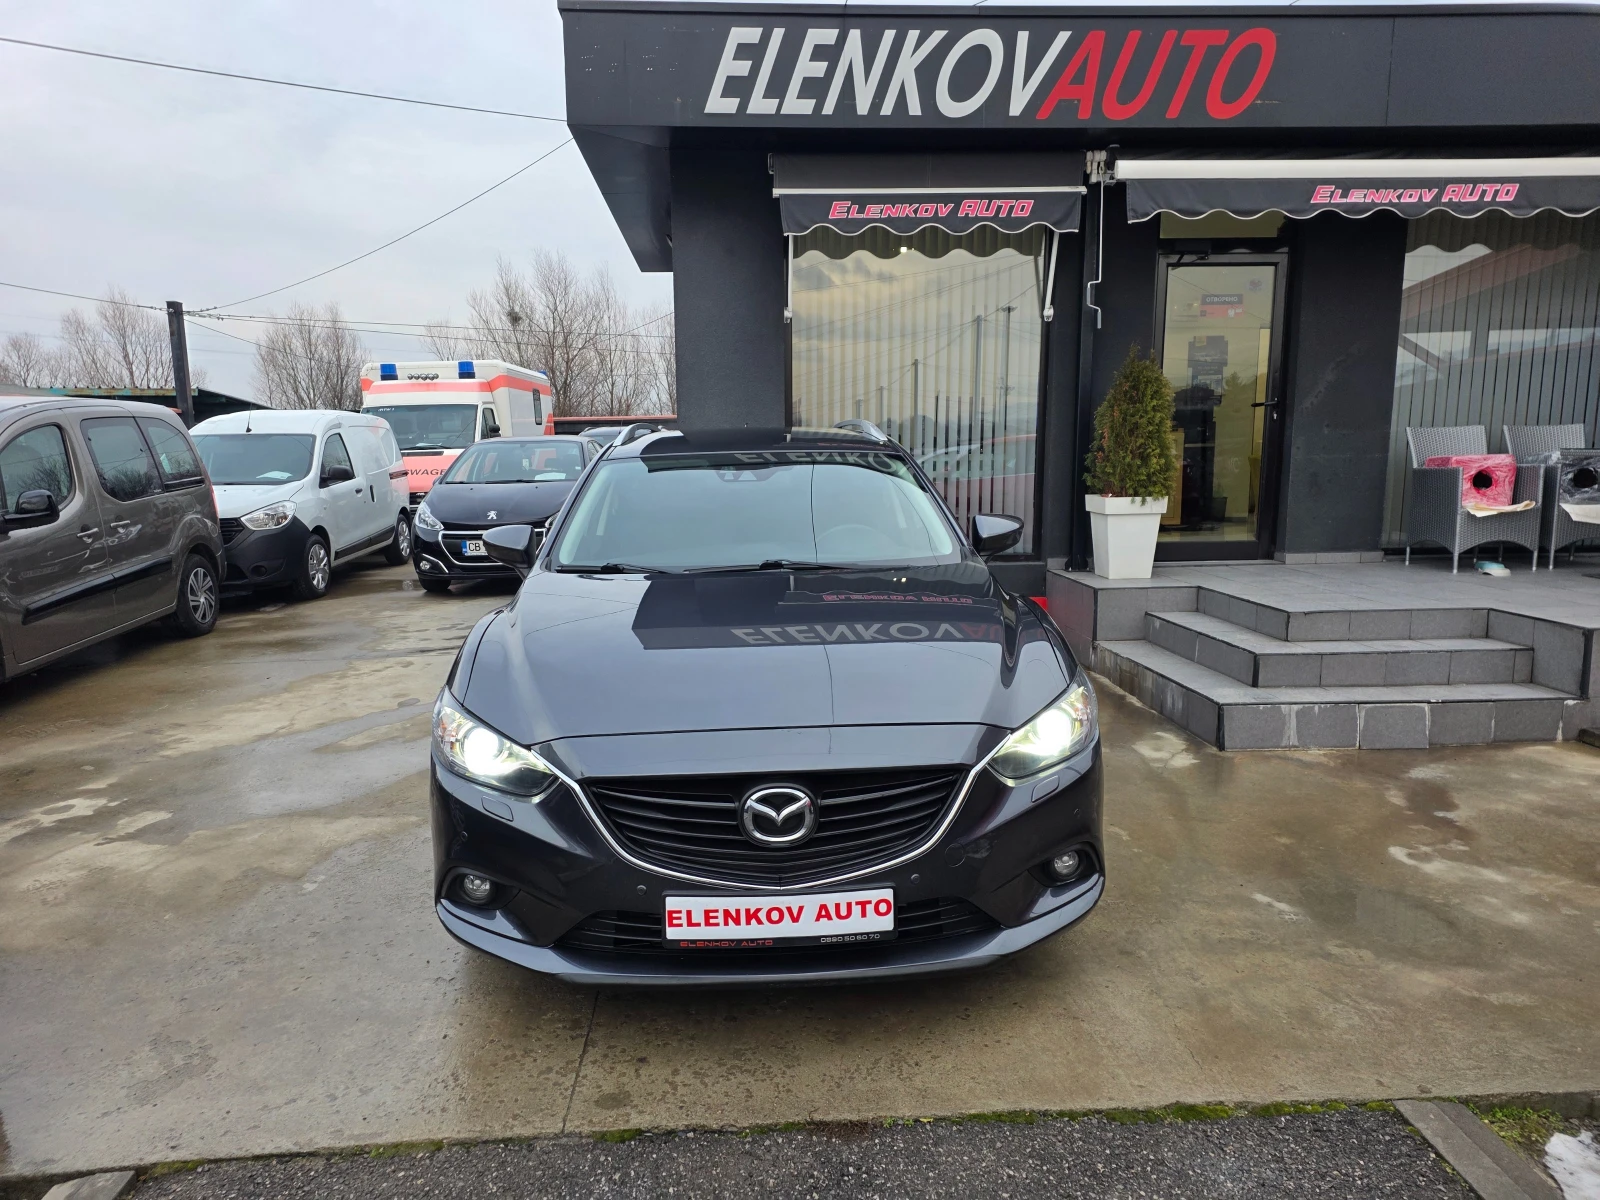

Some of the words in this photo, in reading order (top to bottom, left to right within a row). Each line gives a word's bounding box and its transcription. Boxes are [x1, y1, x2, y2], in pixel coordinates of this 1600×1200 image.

[1311, 185, 1438, 203] ELENKOV
[1442, 184, 1519, 202] AUTO
[829, 201, 954, 218] ELENKOV
[958, 200, 1034, 217] AUTO
[666, 905, 804, 928] ELENKOV
[814, 898, 893, 922] AUTO
